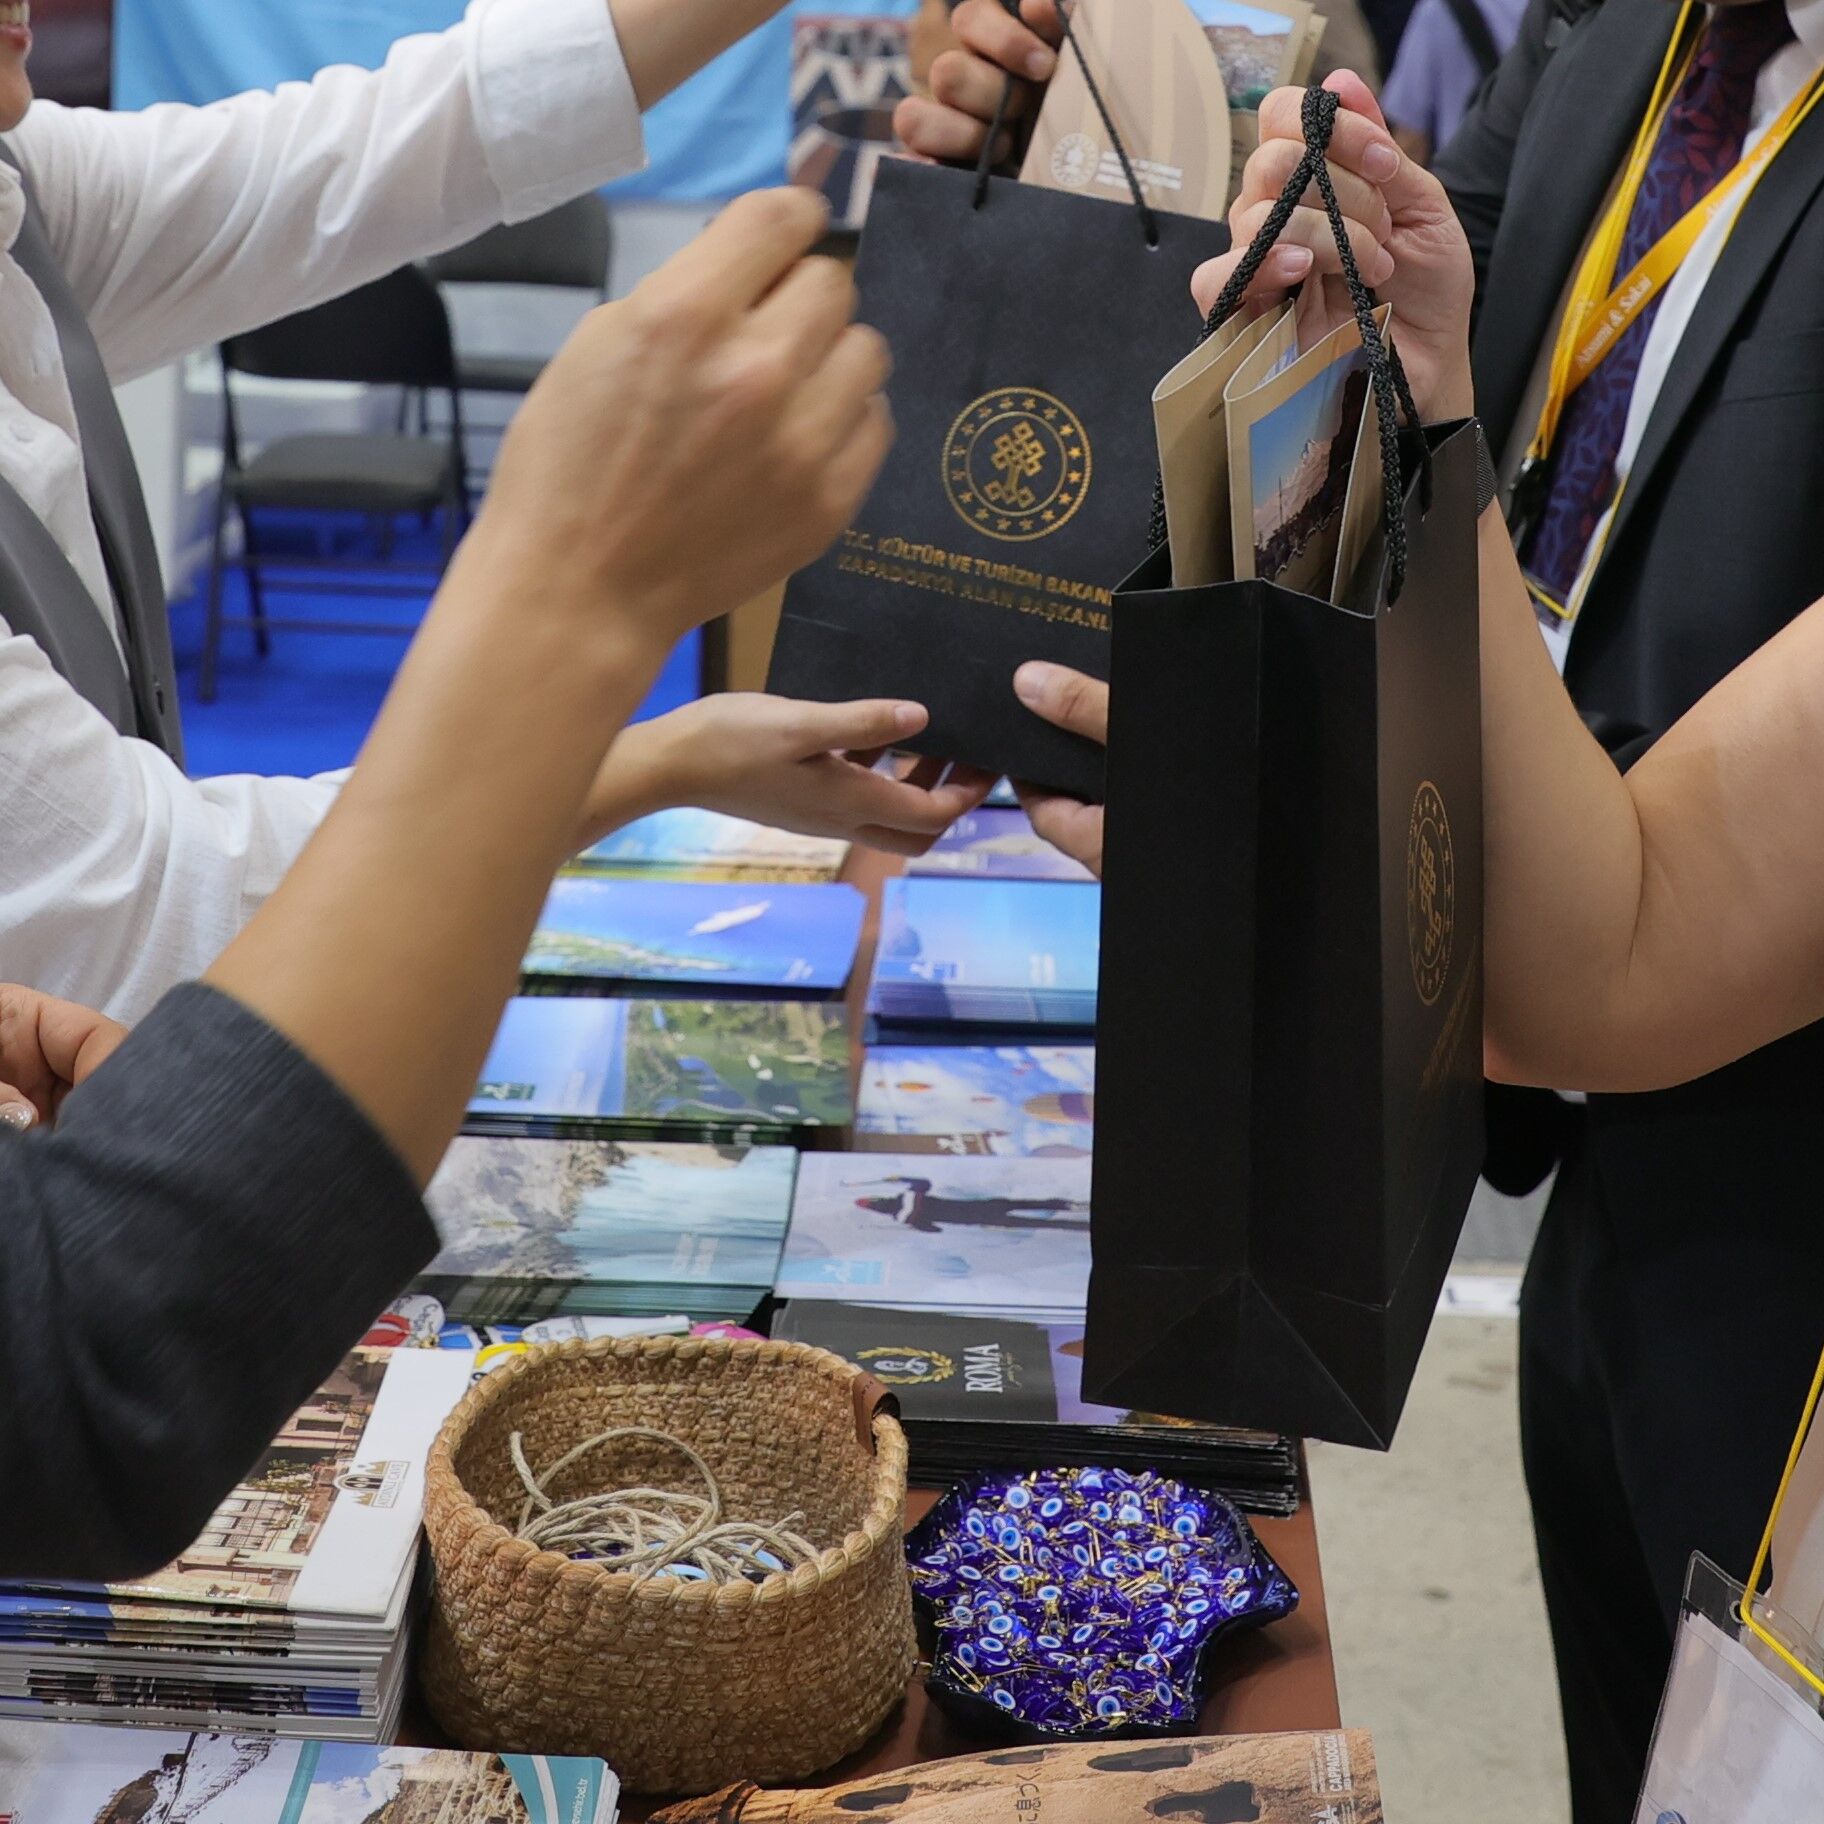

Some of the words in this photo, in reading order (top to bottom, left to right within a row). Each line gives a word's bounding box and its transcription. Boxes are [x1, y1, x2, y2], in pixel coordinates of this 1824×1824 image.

[878, 536, 947, 568] KÜLTÜR
[948, 552, 973, 573] VE
[975, 558, 1043, 591] TURİZM
[963, 1343, 1003, 1393] ROMA
[1324, 1734, 1343, 1792] CAPPADOCIA
